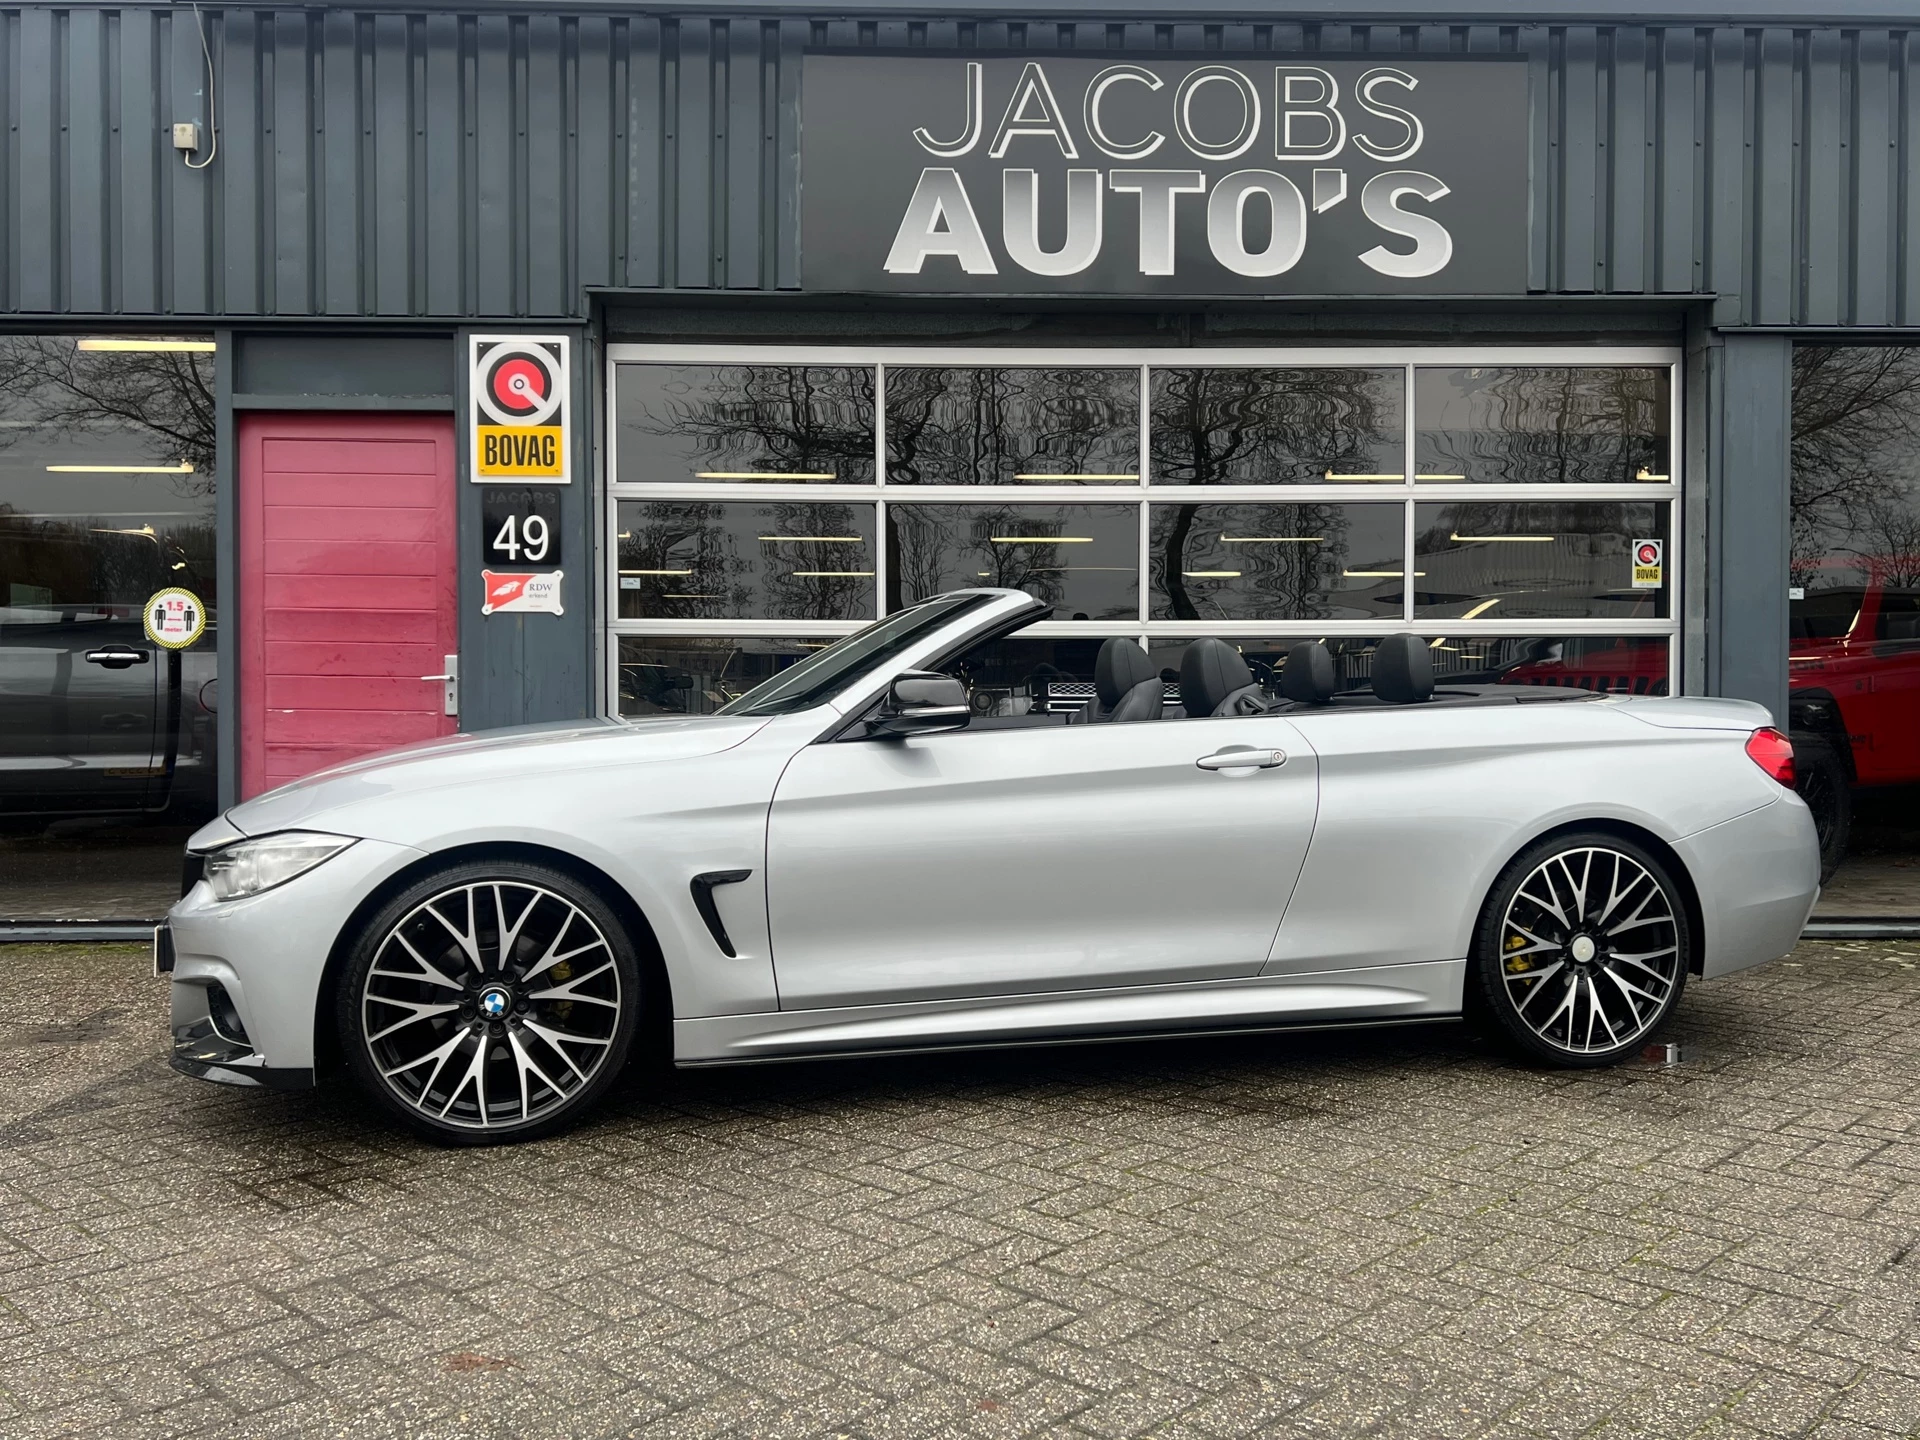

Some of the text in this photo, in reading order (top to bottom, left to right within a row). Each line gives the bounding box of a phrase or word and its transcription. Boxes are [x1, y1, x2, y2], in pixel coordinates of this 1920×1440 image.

[913, 62, 1424, 162] JACOBS
[883, 167, 1453, 277] AUTO'S
[484, 434, 555, 467] BOVAG
[492, 514, 549, 561] 49
[529, 583, 553, 591] RDW
[1636, 568, 1658, 580] BOVAG
[166, 601, 184, 611] 1.5
